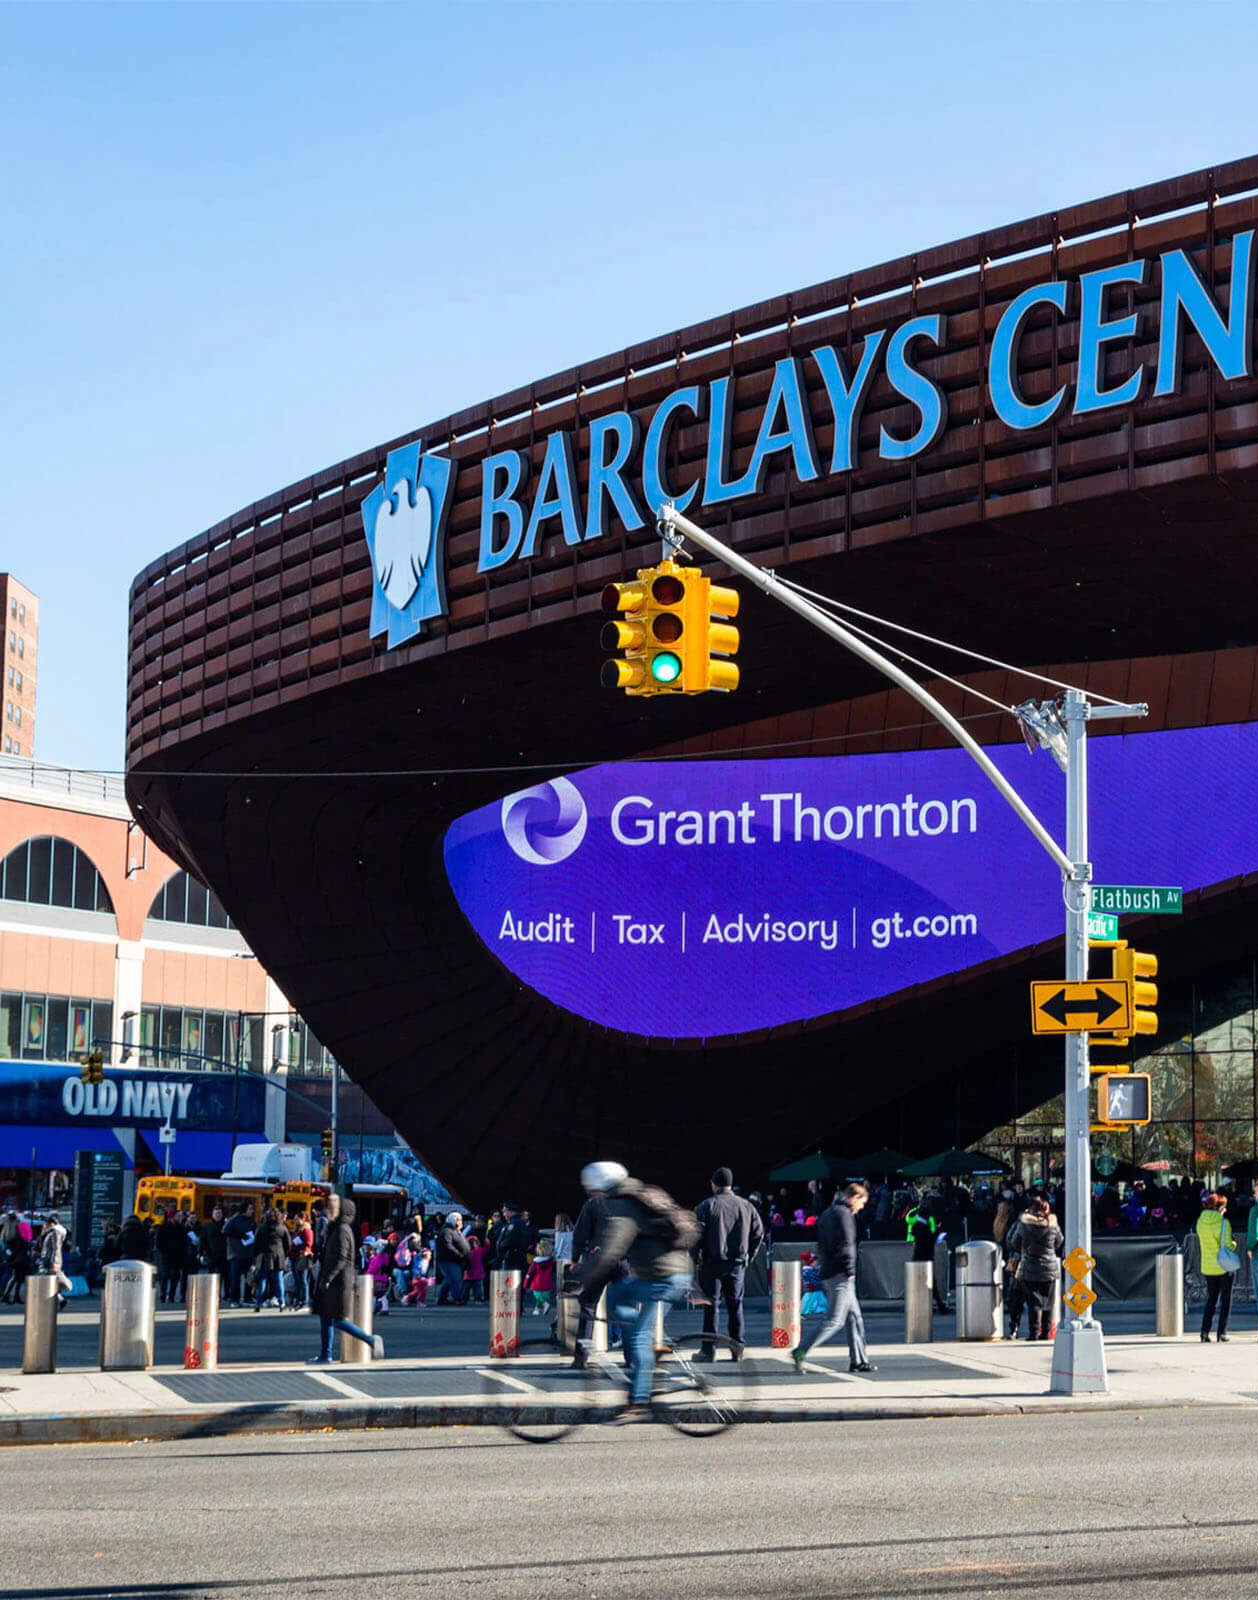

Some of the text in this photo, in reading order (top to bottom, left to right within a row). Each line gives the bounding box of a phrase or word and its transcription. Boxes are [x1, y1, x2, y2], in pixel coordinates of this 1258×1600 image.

[477, 314, 947, 574] BARCLAYS
[611, 792, 978, 846] Grant Thornton
[1092, 888, 1160, 909] Flatbush
[499, 910, 978, 950] Audit Tax Advisory gt.com
[62, 1076, 193, 1119] OLD NAVY
